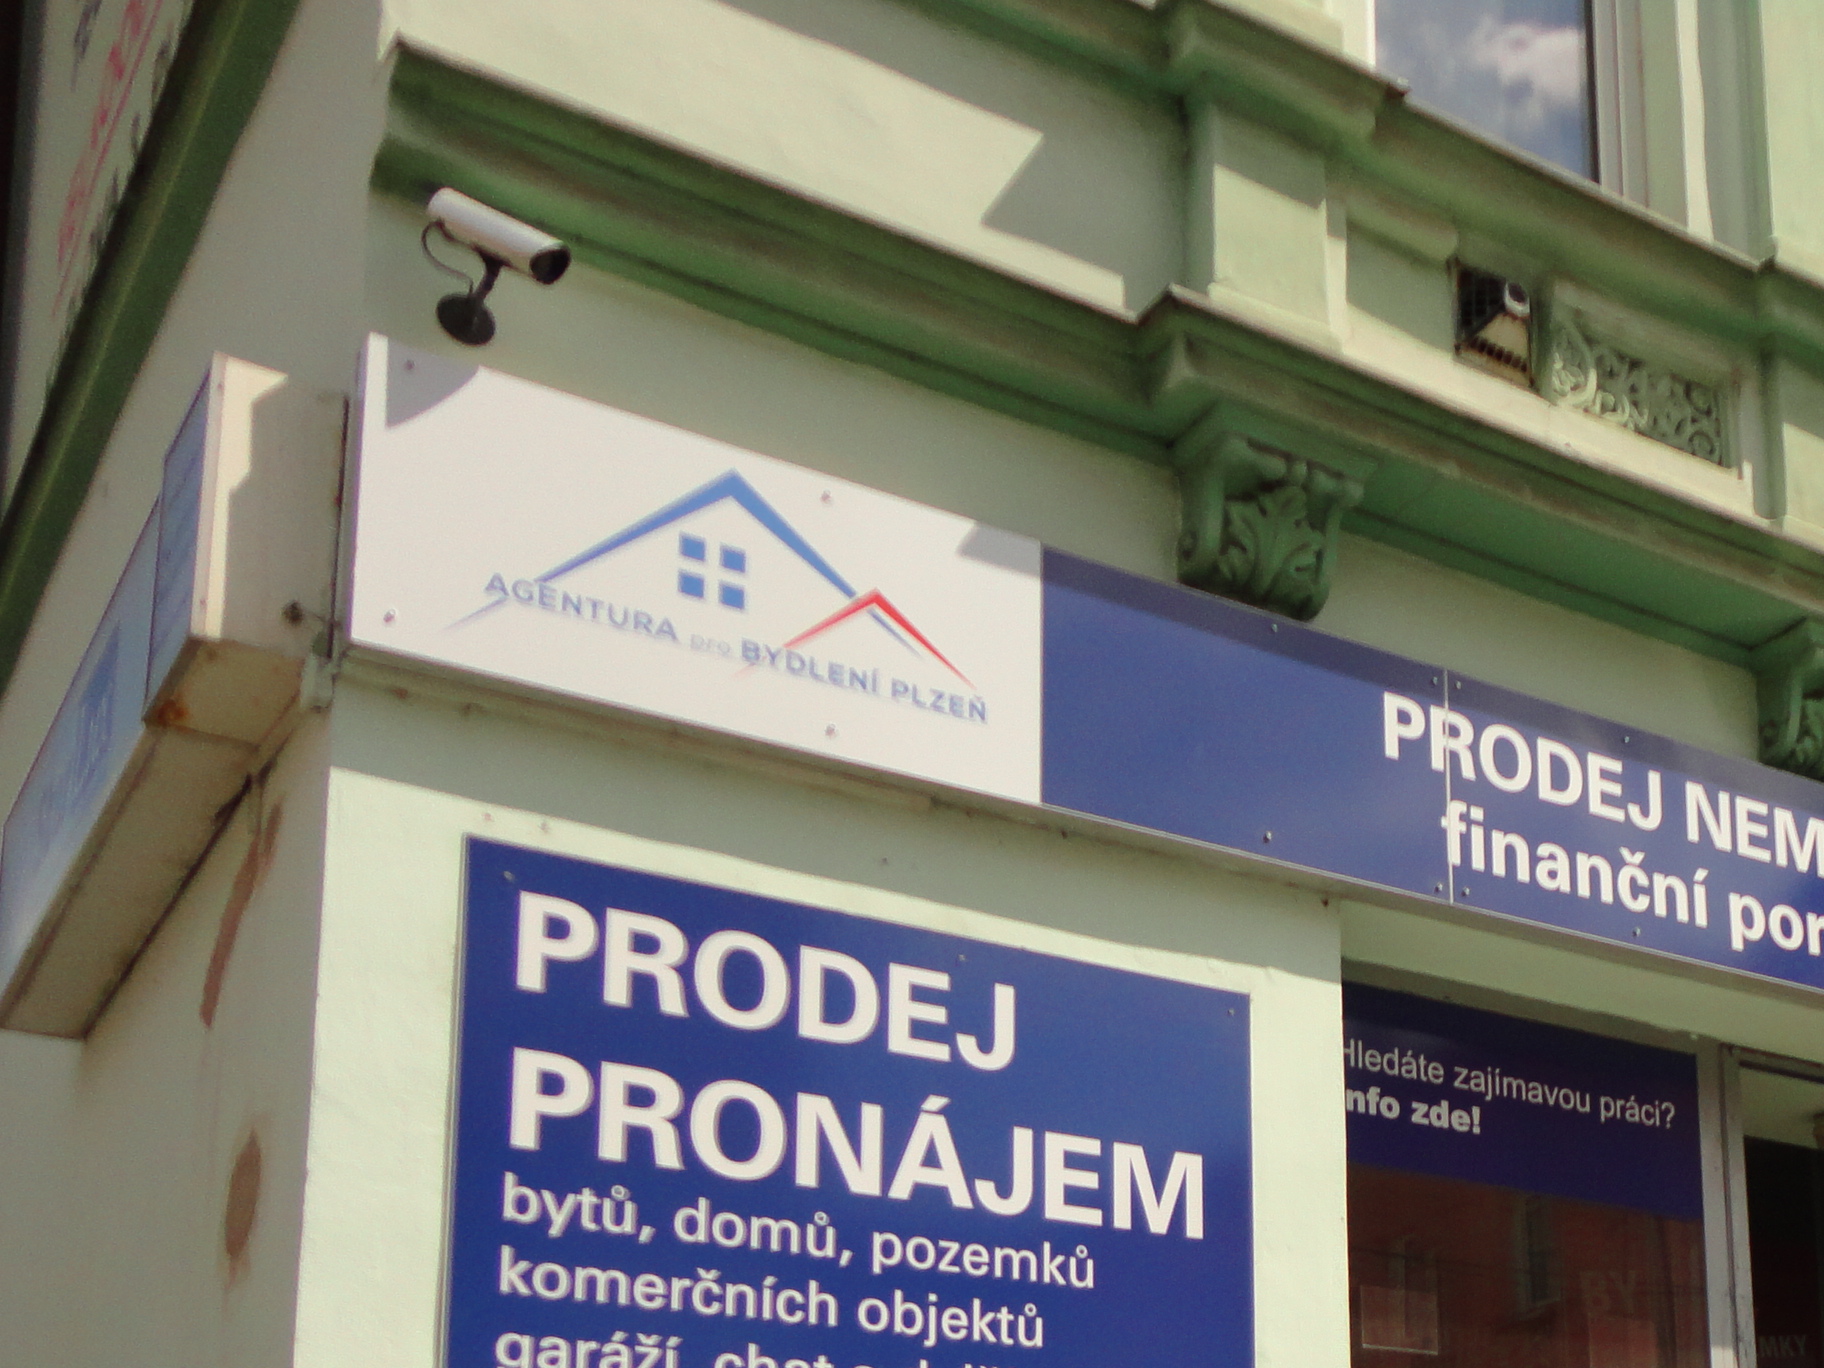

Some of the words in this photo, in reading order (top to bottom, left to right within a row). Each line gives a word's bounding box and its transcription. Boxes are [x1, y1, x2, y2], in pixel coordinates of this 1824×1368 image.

[485, 572, 679, 642] AGENTURA
[741, 637, 881, 696] BYDLENÍ
[890, 676, 988, 724] PLZEŇ
[1383, 692, 1663, 831] PRODEJ
[1441, 800, 1708, 928] finanční
[514, 890, 1016, 1071] PRODEJ
[508, 1046, 1205, 1240] PRONÁJEM
[1346, 1086, 1401, 1120] nfo
[1411, 1099, 1481, 1135] zde!
[1453, 1064, 1591, 1114] zajímavou
[1600, 1094, 1676, 1130] práci?
[502, 1172, 655, 1244] bytů,
[673, 1196, 853, 1268] domů,
[871, 1224, 1096, 1289] pozemků
[499, 1246, 838, 1327] komerčních
[857, 1290, 1045, 1348] objektů
